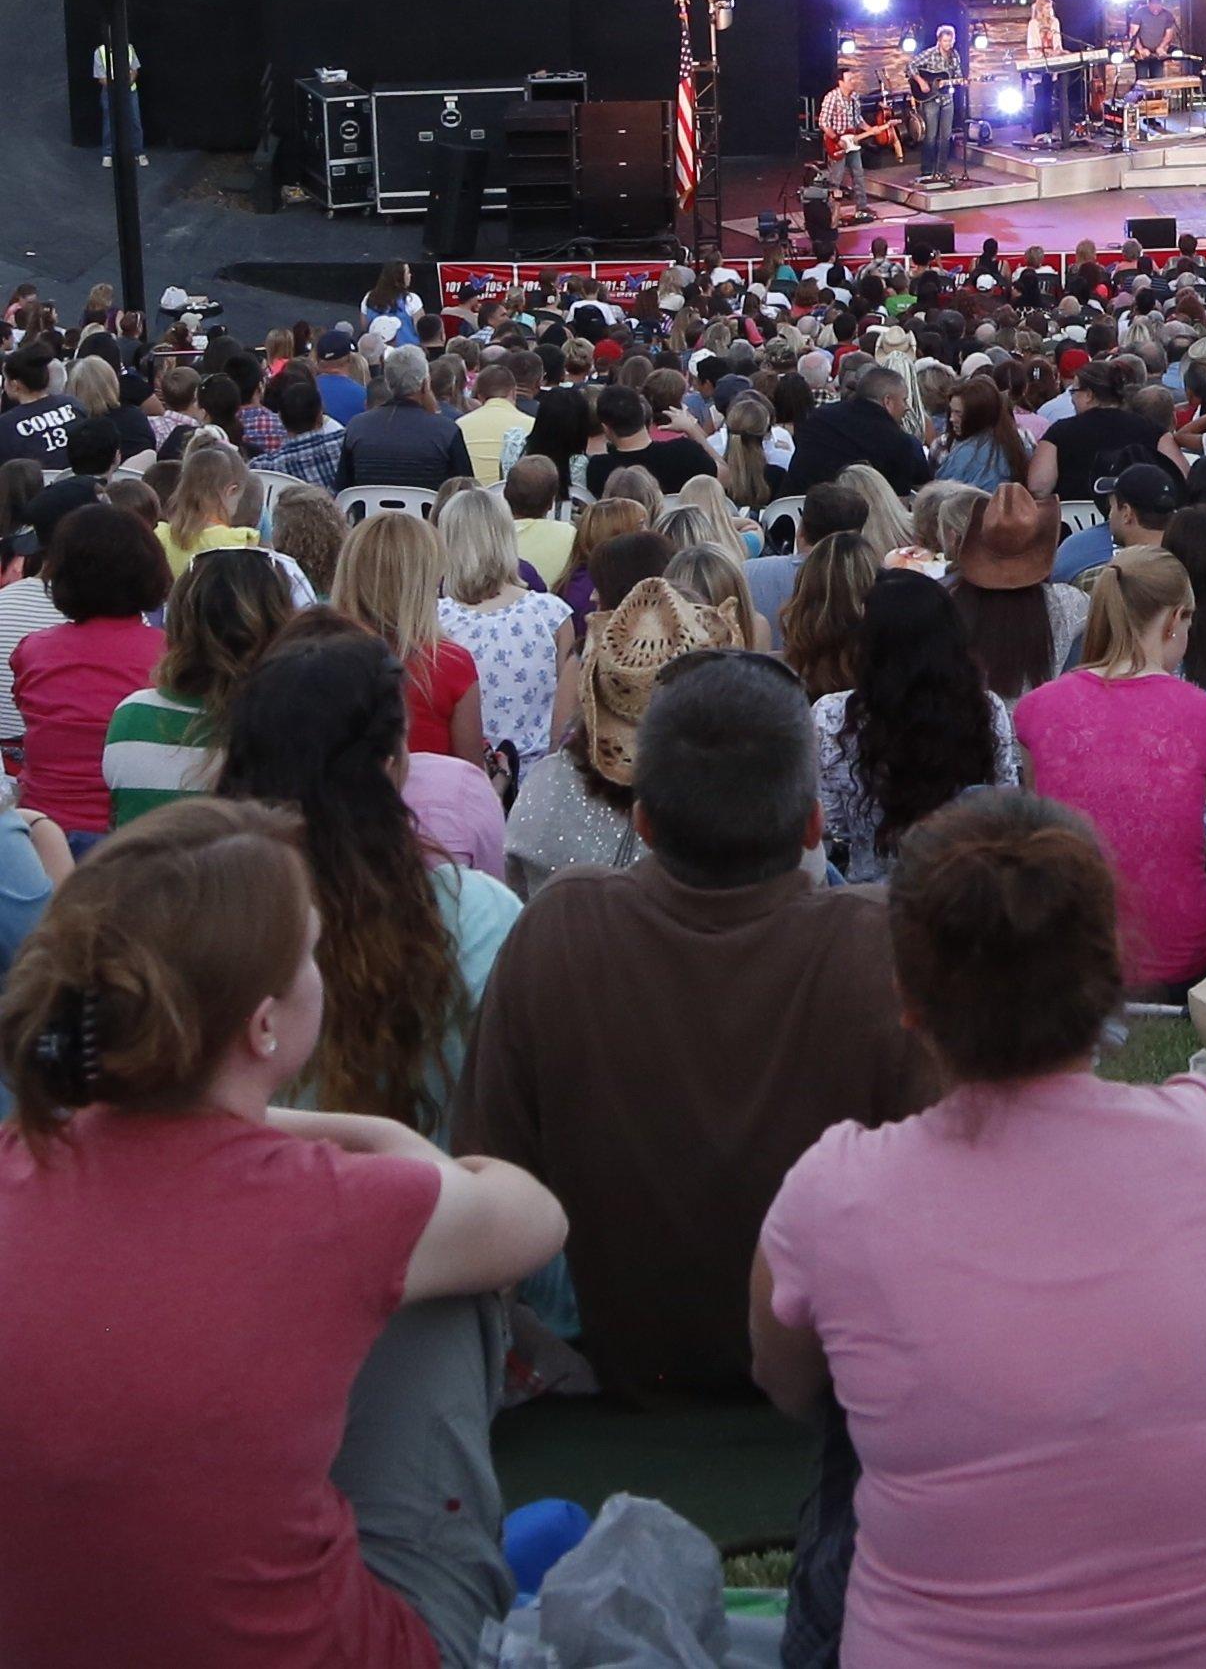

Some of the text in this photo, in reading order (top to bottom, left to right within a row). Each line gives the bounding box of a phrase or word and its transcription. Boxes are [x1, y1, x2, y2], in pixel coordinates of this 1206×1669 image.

[486, 281, 511, 292] 105.1
[522, 281, 541, 292] 101.
[16, 404, 76, 436] CORE
[42, 427, 69, 451] 13
